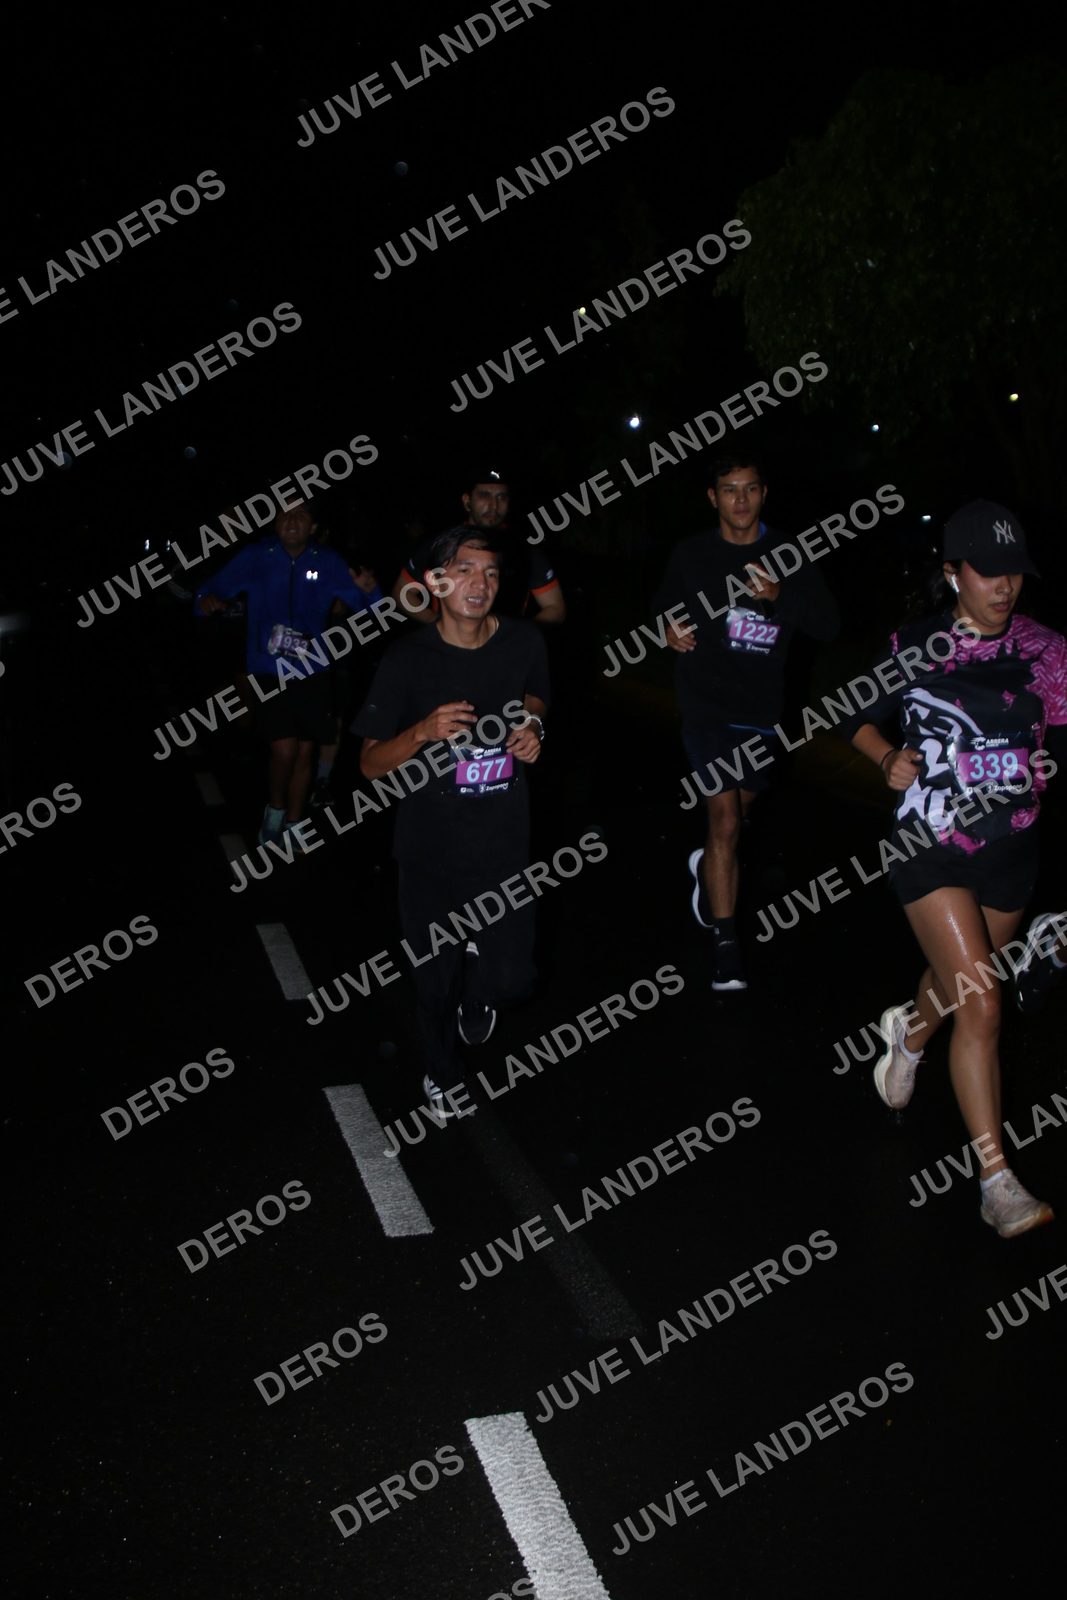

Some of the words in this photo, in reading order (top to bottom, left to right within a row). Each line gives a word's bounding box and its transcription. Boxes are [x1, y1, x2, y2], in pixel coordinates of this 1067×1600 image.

[734, 620, 778, 644] 1222
[466, 757, 506, 783] 677
[969, 752, 1018, 779] 339
